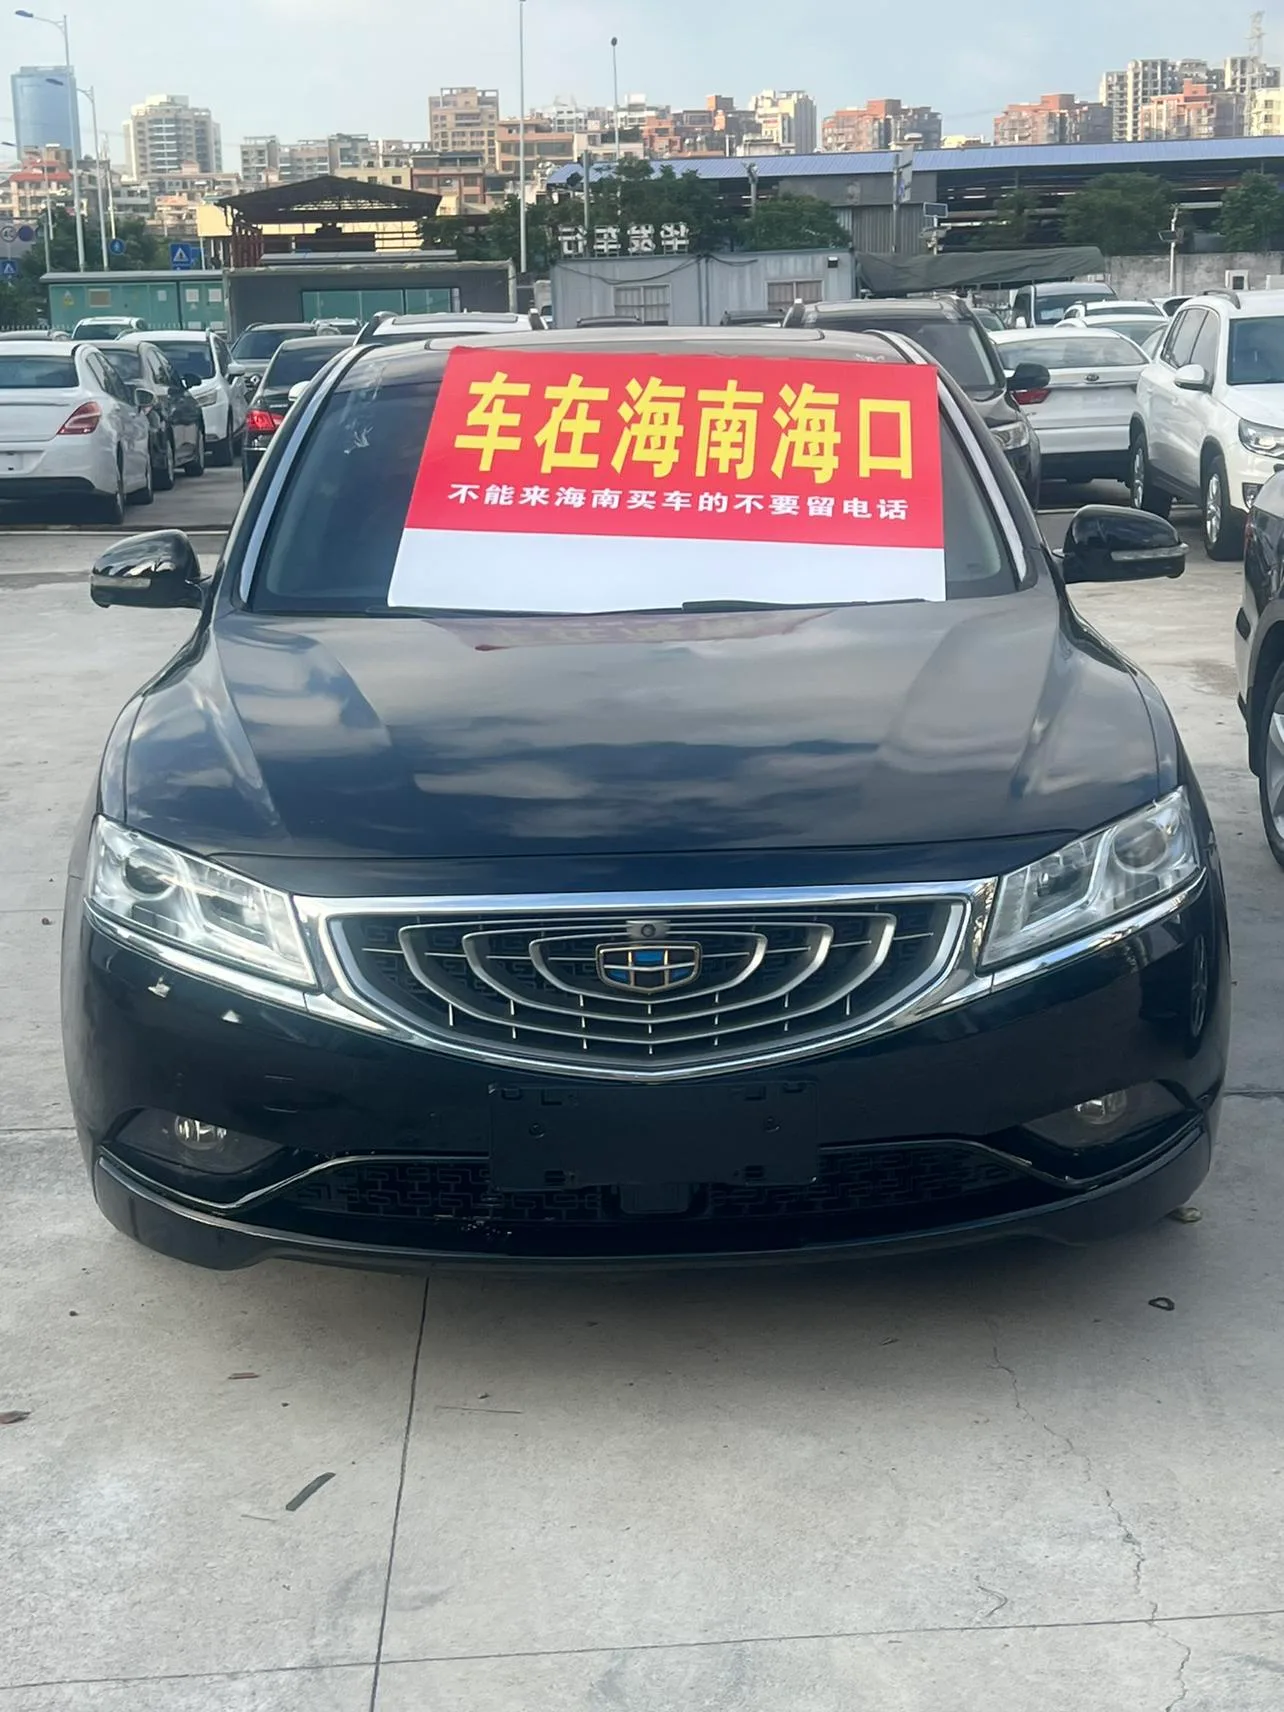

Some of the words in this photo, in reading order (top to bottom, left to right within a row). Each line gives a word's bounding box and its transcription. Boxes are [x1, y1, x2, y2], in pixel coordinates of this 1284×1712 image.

[453, 371, 912, 484] 车在海南海口
[448, 483, 909, 521] 不能来海南买车的不要留电话
